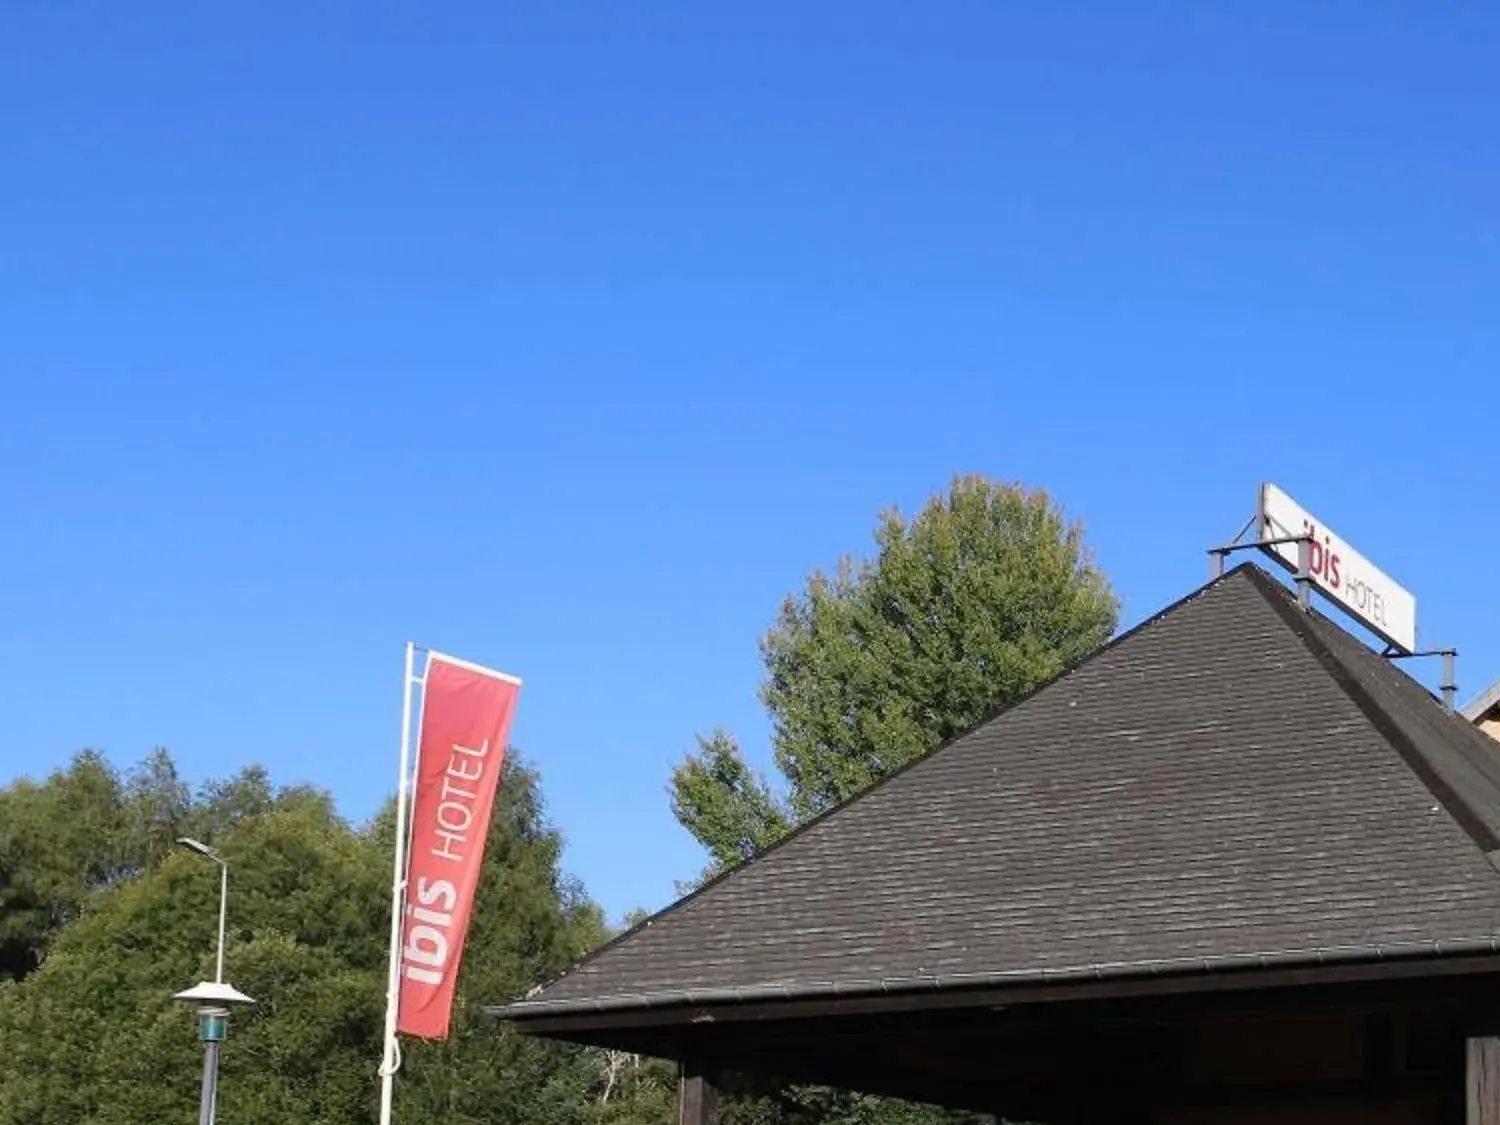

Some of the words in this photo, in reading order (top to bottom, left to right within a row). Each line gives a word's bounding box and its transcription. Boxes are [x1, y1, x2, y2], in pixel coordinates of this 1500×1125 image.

[1345, 573, 1388, 628] HOTEL
[404, 876, 457, 985] ibis
[431, 738, 489, 861] HOTEL
